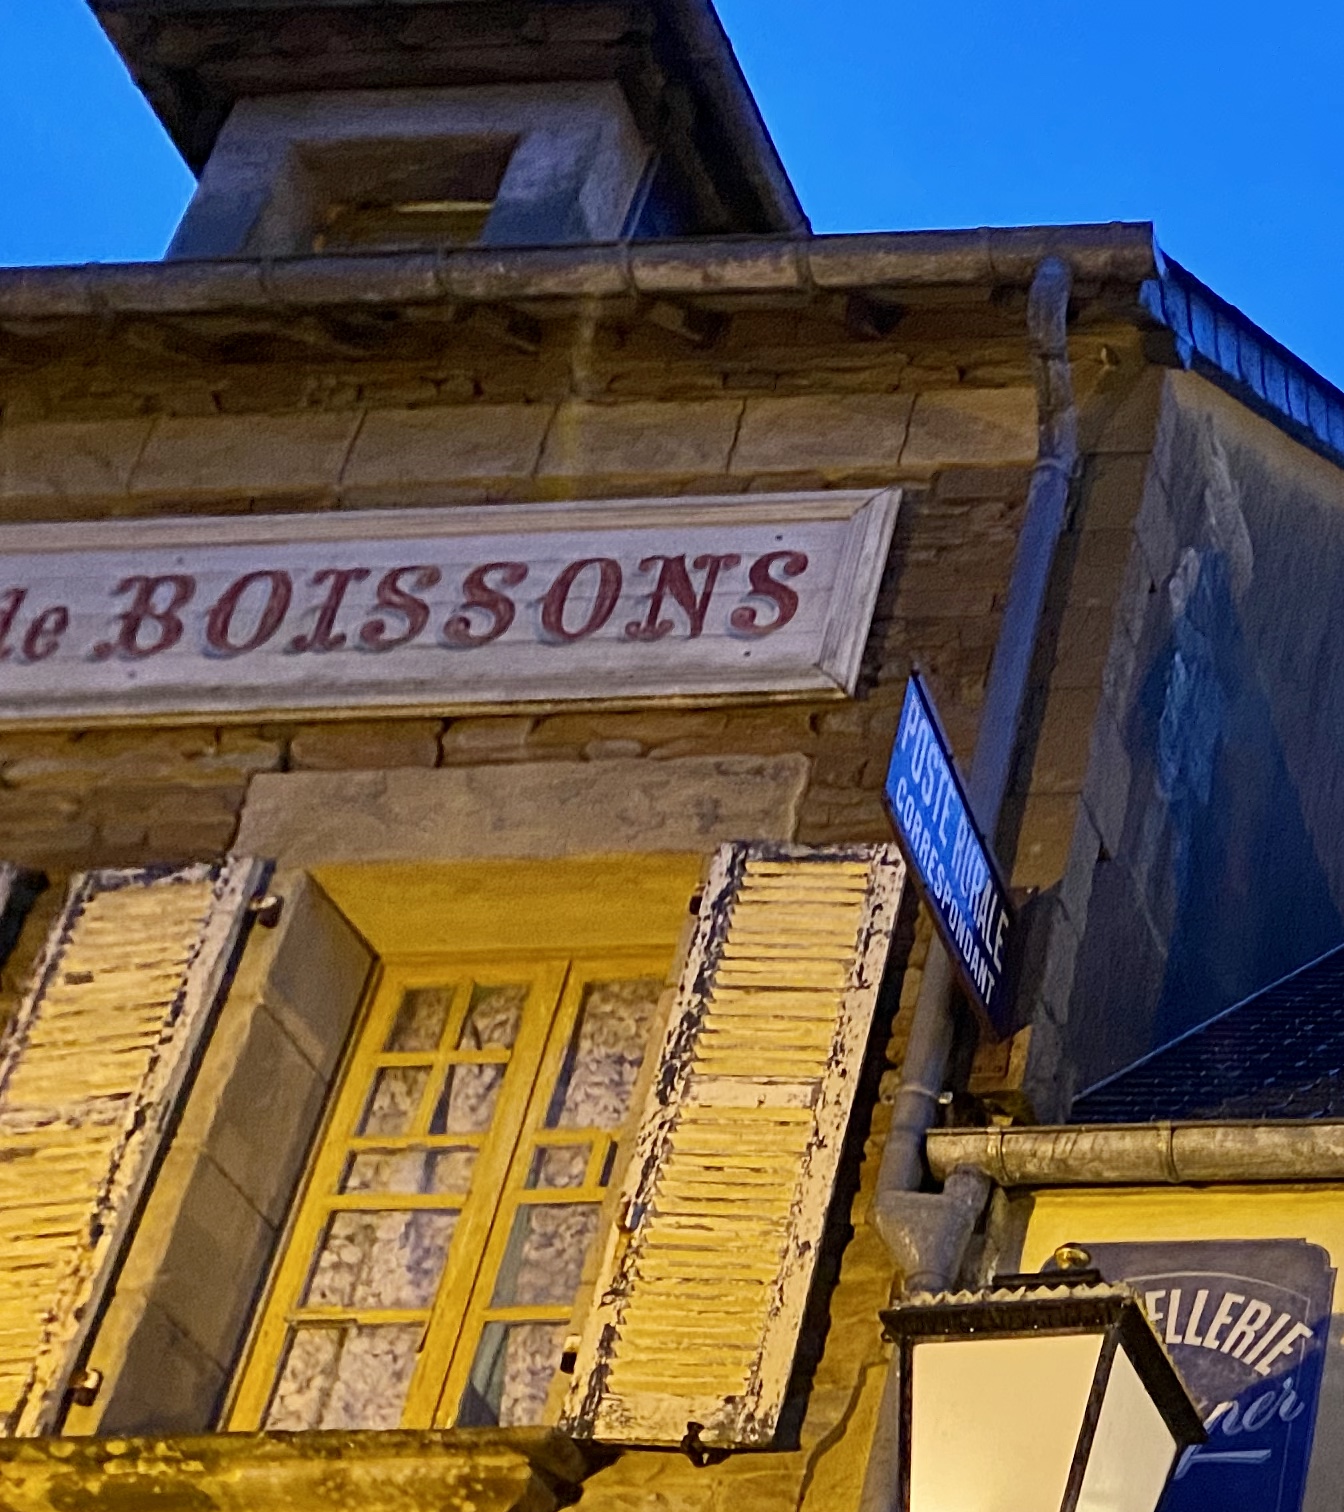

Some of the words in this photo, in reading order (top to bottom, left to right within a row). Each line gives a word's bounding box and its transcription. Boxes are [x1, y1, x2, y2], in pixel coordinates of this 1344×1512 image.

[92, 549, 809, 660] BOISSONS
[895, 776, 996, 1005] CORRESPONDANT
[901, 695, 956, 848] POSTE
[951, 811, 1009, 974] RURALE
[1144, 1288, 1314, 1377] ELLERIE
